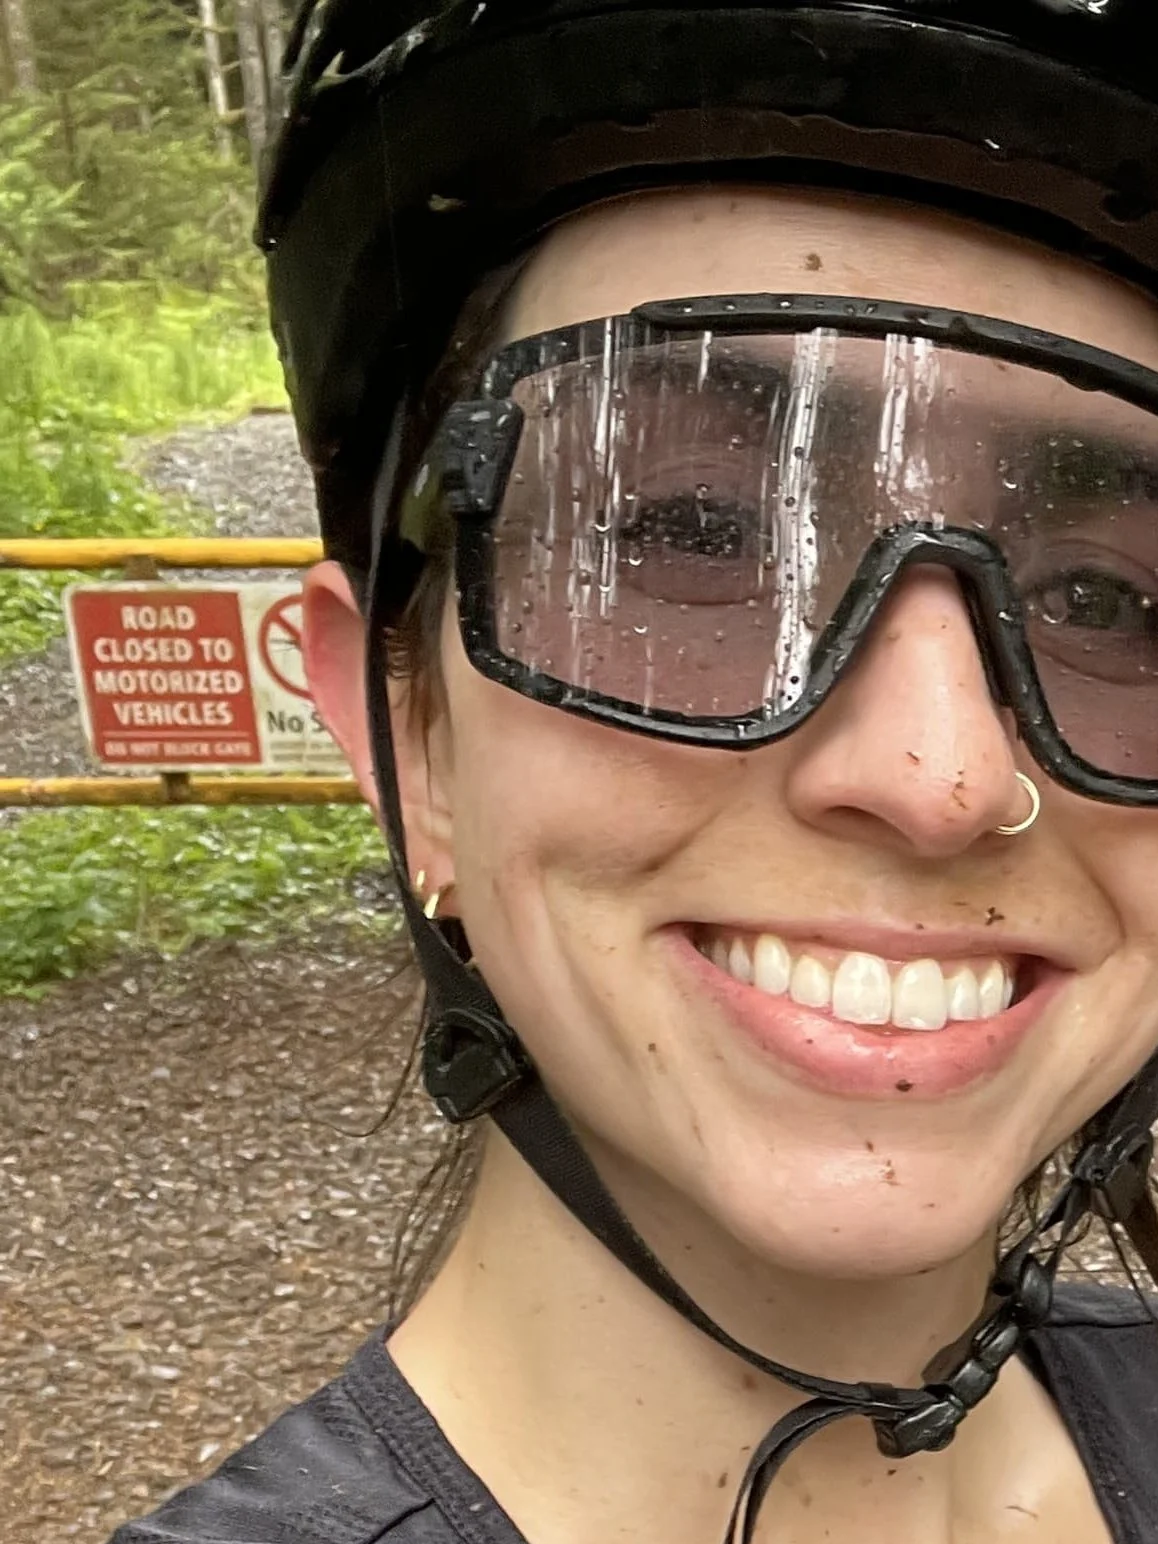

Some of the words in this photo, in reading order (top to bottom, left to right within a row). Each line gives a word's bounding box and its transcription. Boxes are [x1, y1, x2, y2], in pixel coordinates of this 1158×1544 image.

[121, 605, 196, 631] ROAD
[94, 637, 194, 663] CLOSED
[198, 637, 235, 662] TO
[94, 669, 244, 694] MOTORIZED
[112, 701, 234, 726] VEHICLES
[266, 711, 304, 733] No
